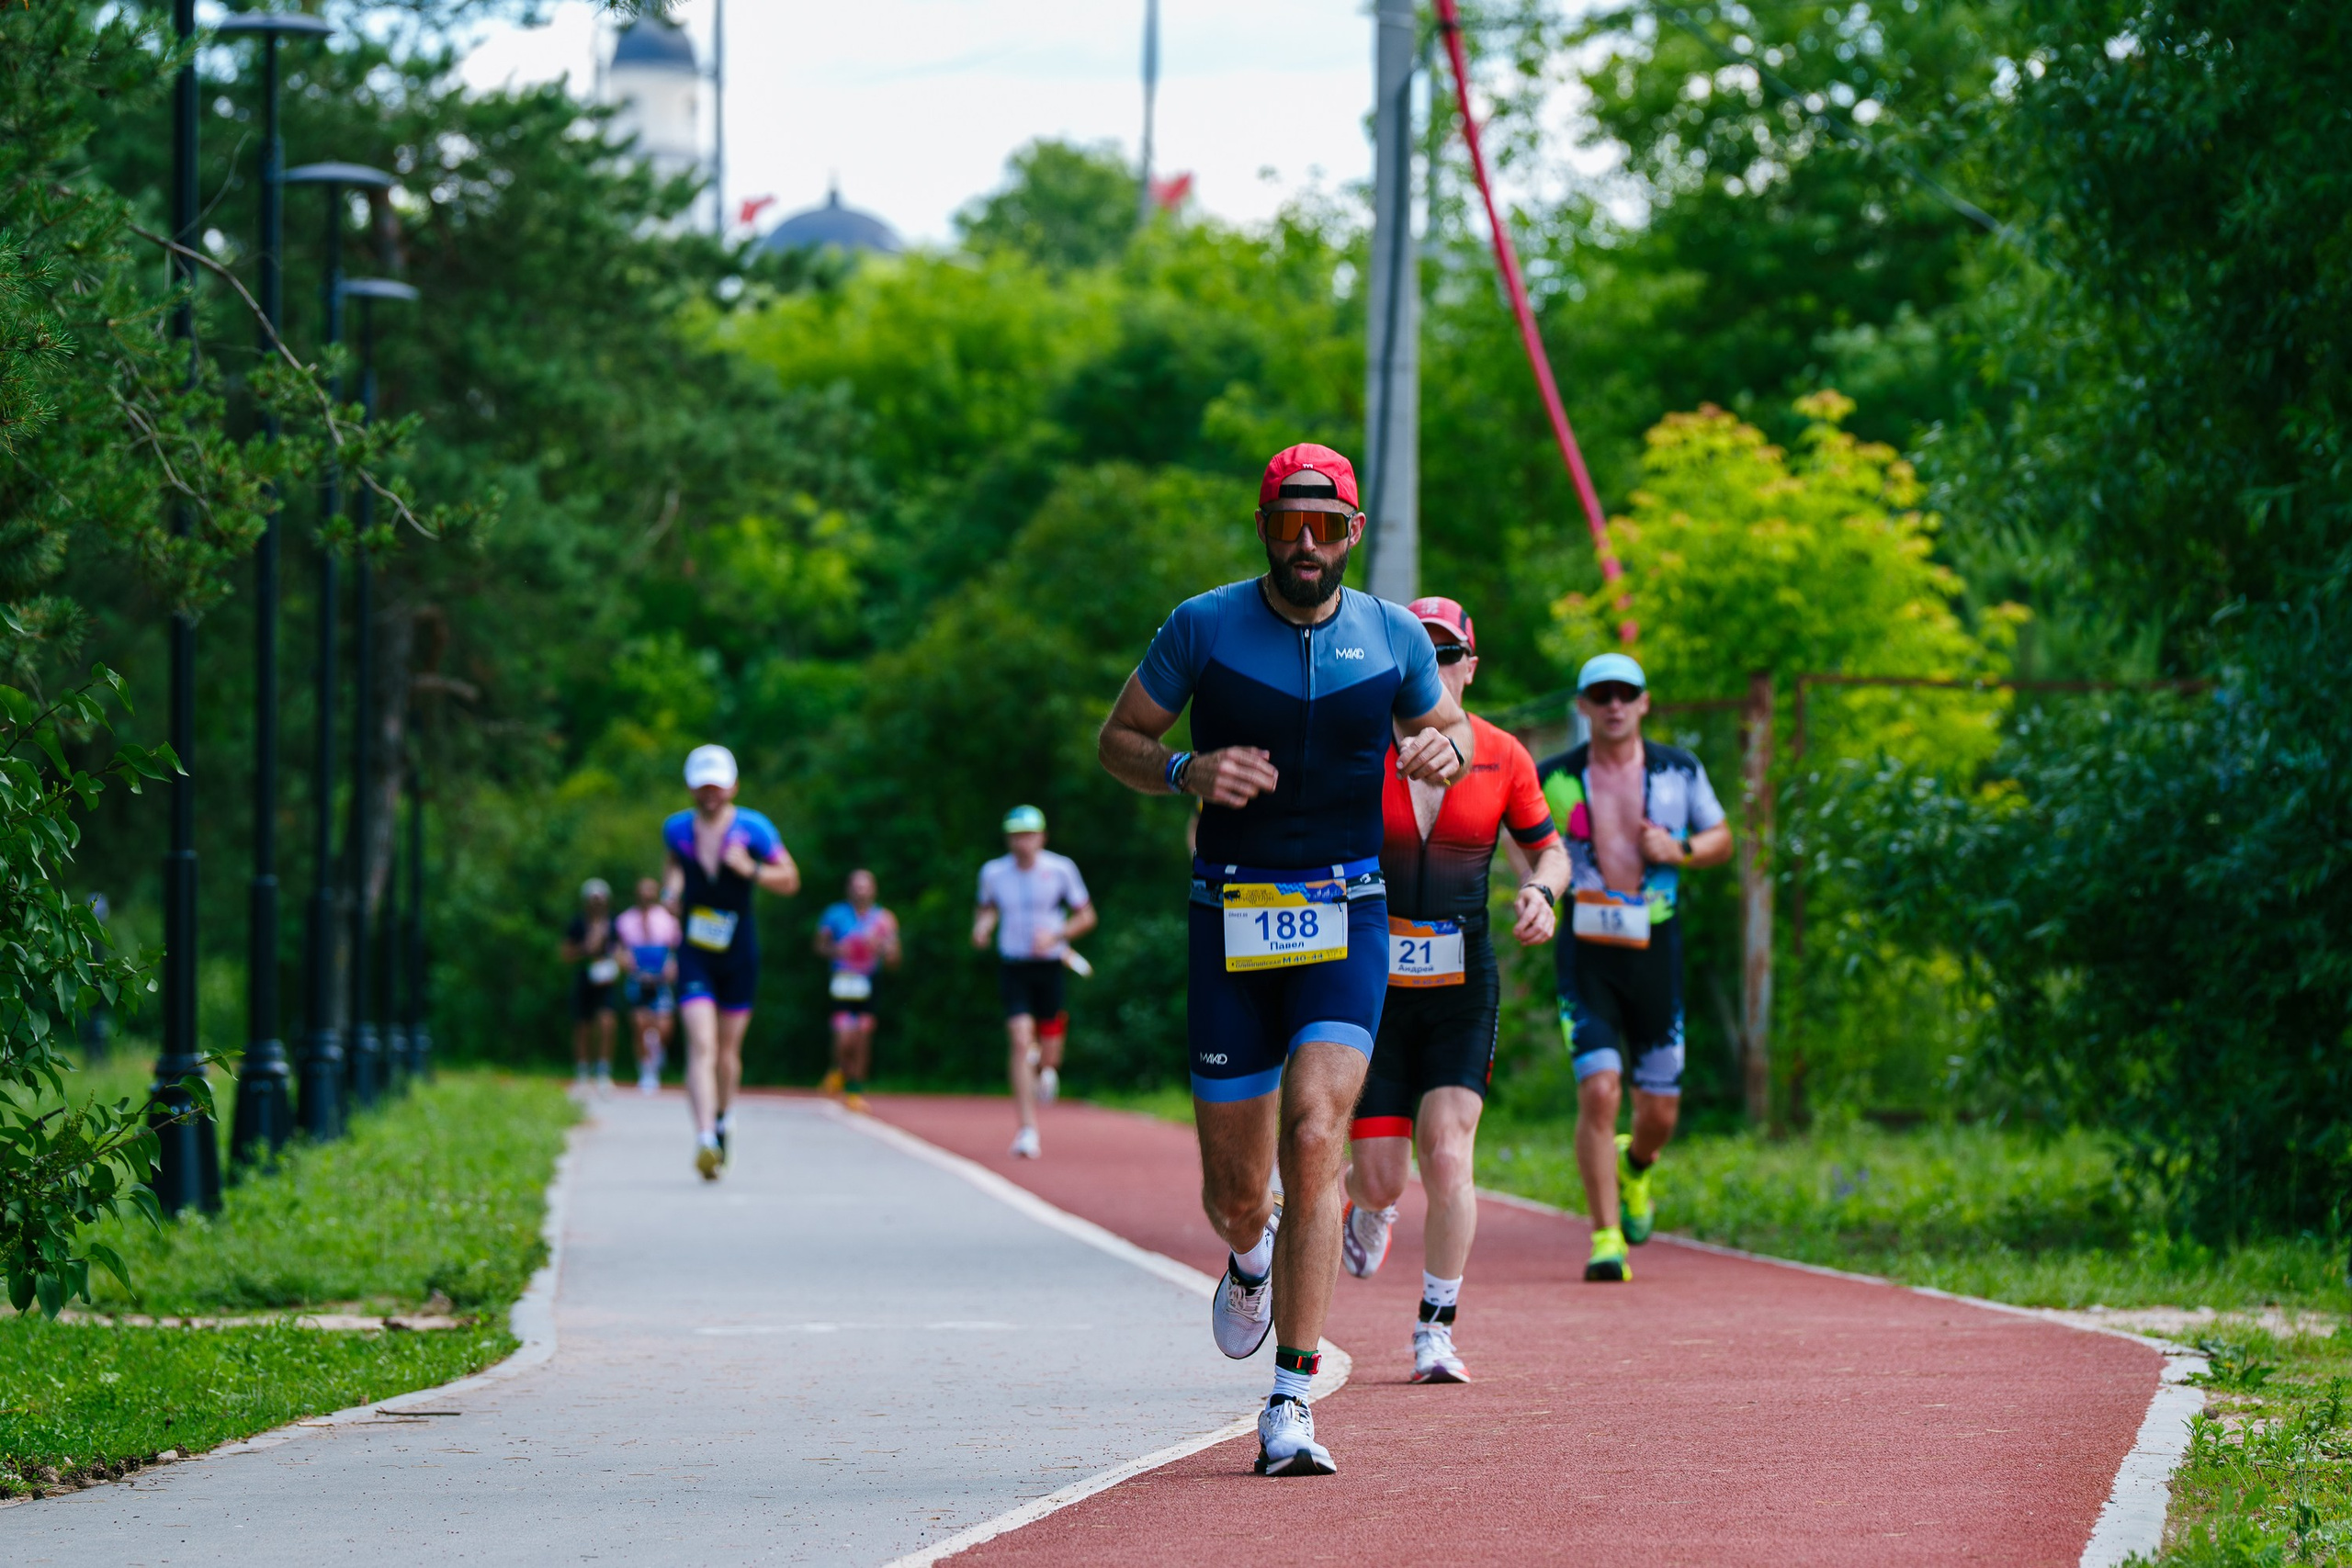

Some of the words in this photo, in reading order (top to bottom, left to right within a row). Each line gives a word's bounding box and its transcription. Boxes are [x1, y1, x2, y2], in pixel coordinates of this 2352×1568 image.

[1335, 648, 1364, 660] MAKO
[1255, 909, 1318, 941] 188
[1270, 942, 1305, 951] Павел
[1398, 940, 1430, 964] 21
[1397, 964, 1433, 974] Андрей
